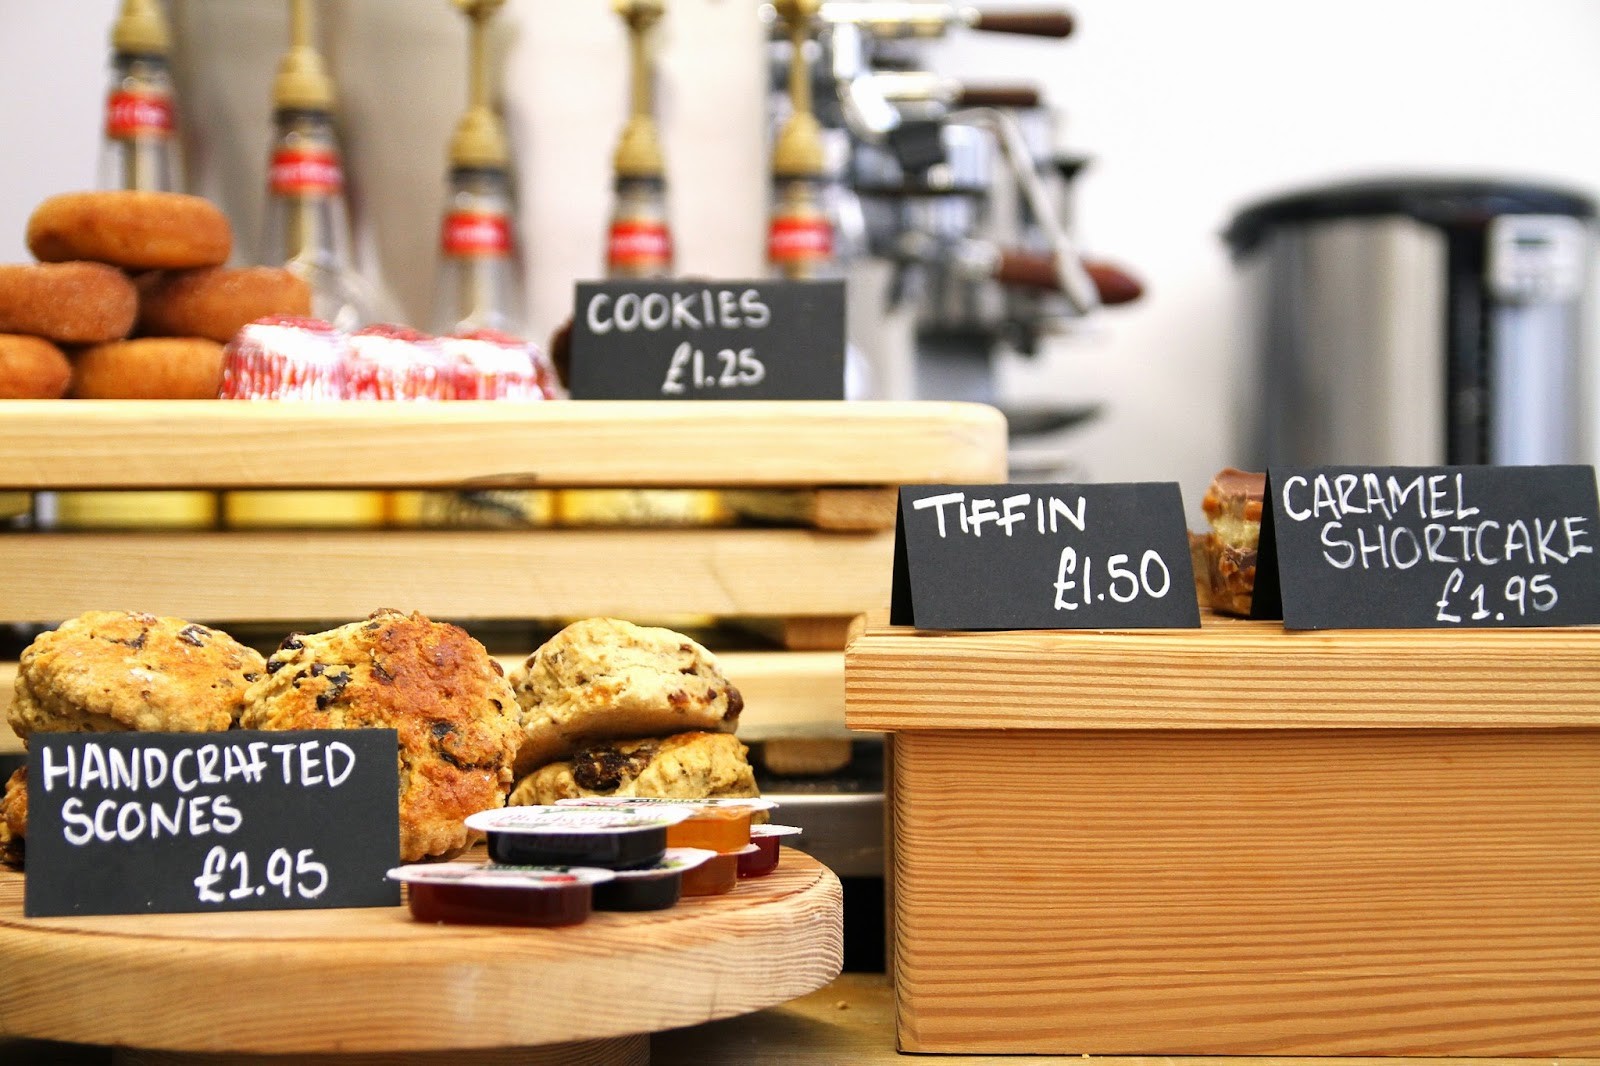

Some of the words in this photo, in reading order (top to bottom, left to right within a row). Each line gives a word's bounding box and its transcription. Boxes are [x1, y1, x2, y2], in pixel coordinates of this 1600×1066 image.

[587, 288, 770, 334] COOKIES
[661, 342, 765, 393] £1.25
[912, 491, 1087, 539] TIFFIN
[1282, 472, 1480, 522] CARAMEL
[1320, 516, 1594, 570] SHORTCAKE
[1052, 545, 1171, 611] £1.50
[1435, 567, 1559, 623] £1.95
[42, 739, 356, 792] HANDCRAFTED
[61, 794, 243, 846] SCONES
[193, 845, 329, 903] £1.95
